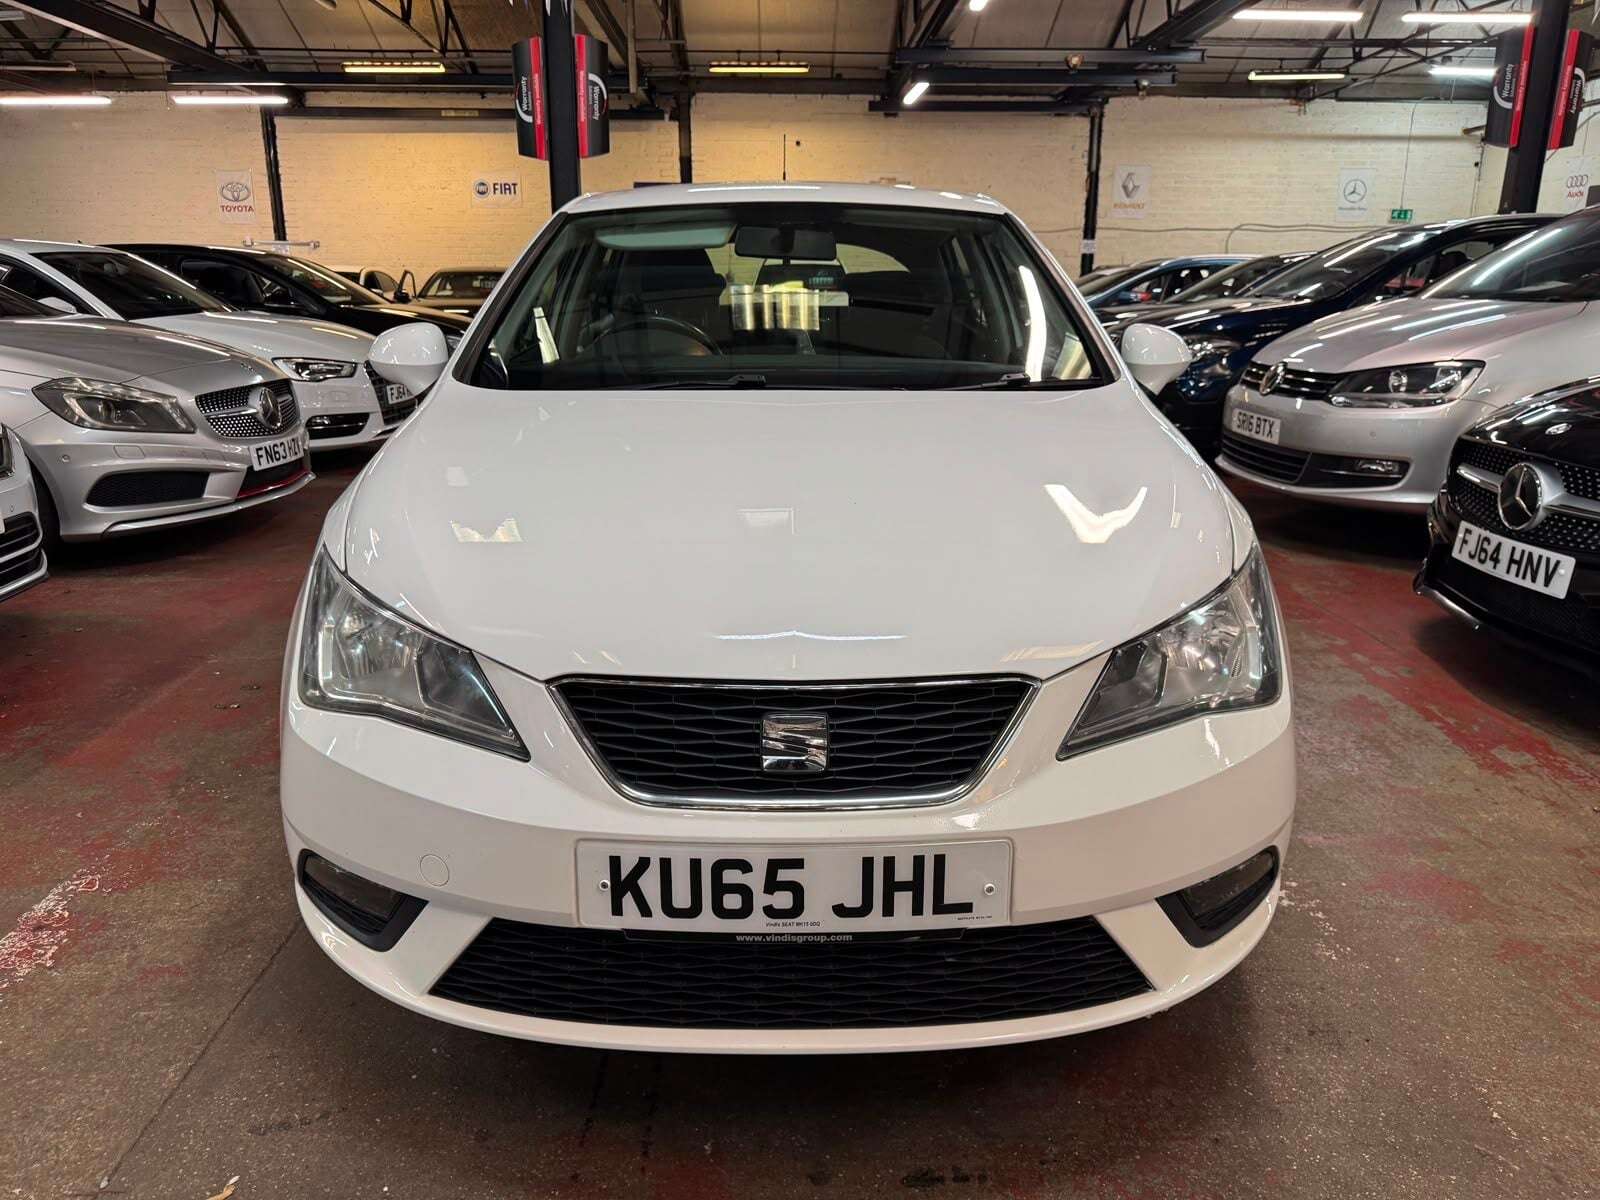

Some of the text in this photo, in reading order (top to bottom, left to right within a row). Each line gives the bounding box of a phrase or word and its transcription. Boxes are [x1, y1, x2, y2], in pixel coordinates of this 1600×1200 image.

[1501, 63, 1514, 98] Warranty
[592, 85, 601, 120] Warranty
[1570, 80, 1582, 113] Warranty
[493, 182, 518, 195] FIAT
[219, 204, 254, 213] TOYOTA
[1237, 411, 1275, 438] SR16 BTX
[255, 441, 287, 466] FN63
[1458, 527, 1561, 588] FJ64 HNV
[608, 853, 973, 920] KU65 JHL
[735, 933, 853, 943] www.vindisgroup.com
